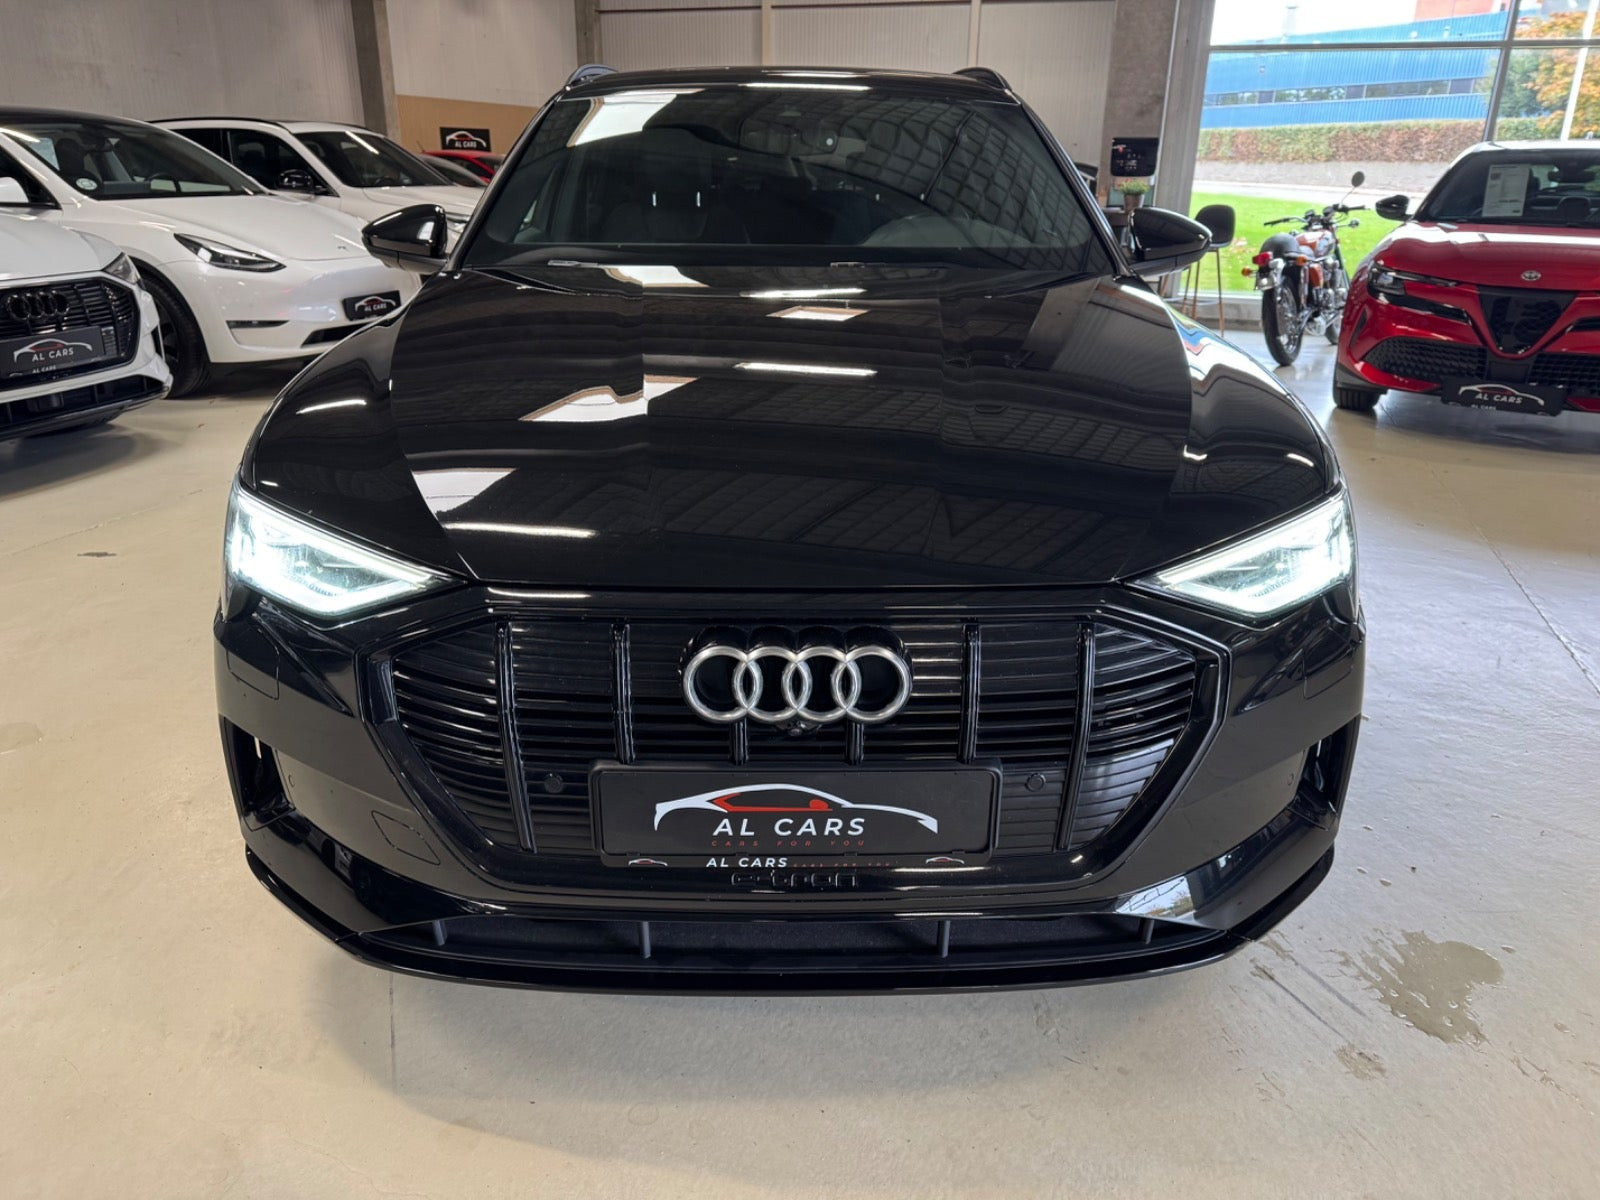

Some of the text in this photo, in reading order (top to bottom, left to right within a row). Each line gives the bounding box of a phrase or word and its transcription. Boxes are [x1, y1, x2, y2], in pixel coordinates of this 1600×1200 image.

[32, 353, 45, 362] AL
[48, 347, 74, 359] CARS
[41, 365, 57, 373] CARS
[1475, 393, 1523, 404] AL CARS
[712, 818, 866, 837] AL CARS
[706, 857, 729, 868] AL
[738, 857, 788, 868] CARS
